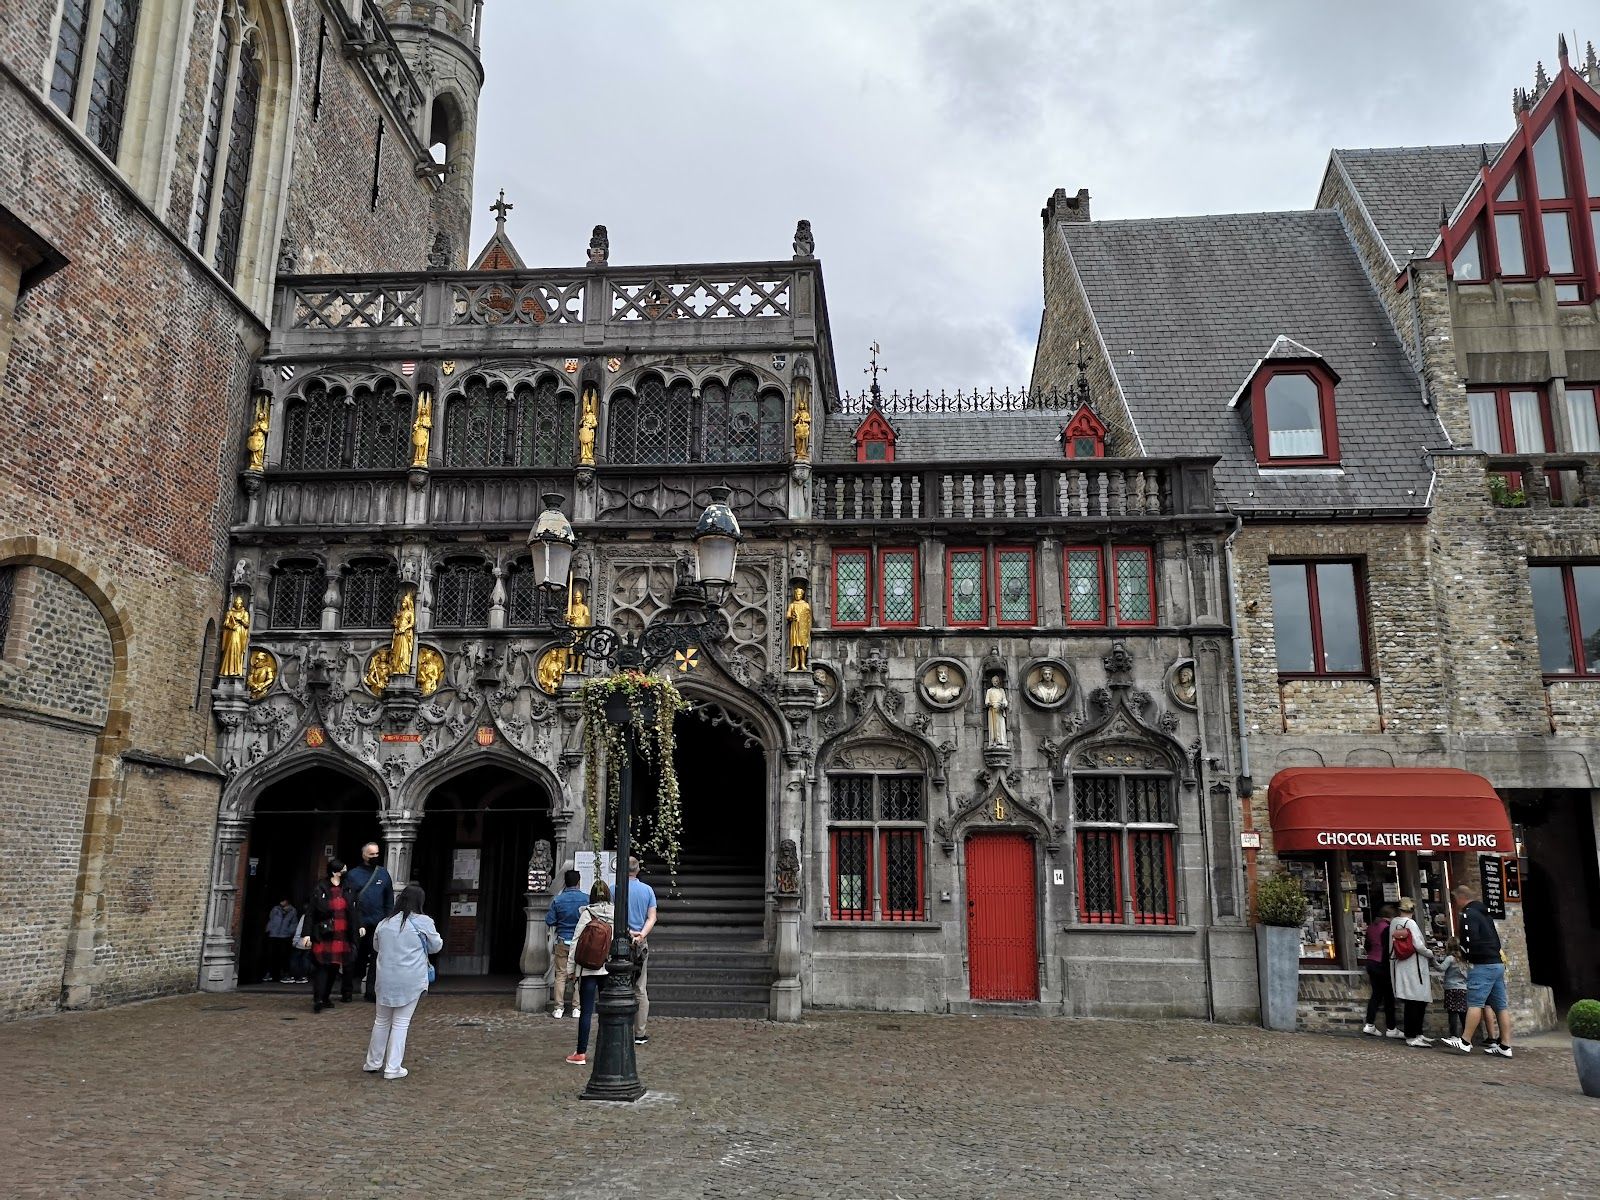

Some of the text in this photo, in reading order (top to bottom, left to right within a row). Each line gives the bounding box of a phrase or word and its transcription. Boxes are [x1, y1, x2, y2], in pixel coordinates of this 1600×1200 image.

[1316, 832, 1497, 847] CHOCOLATERIE DE BURG
[1055, 873, 1063, 881] 14
